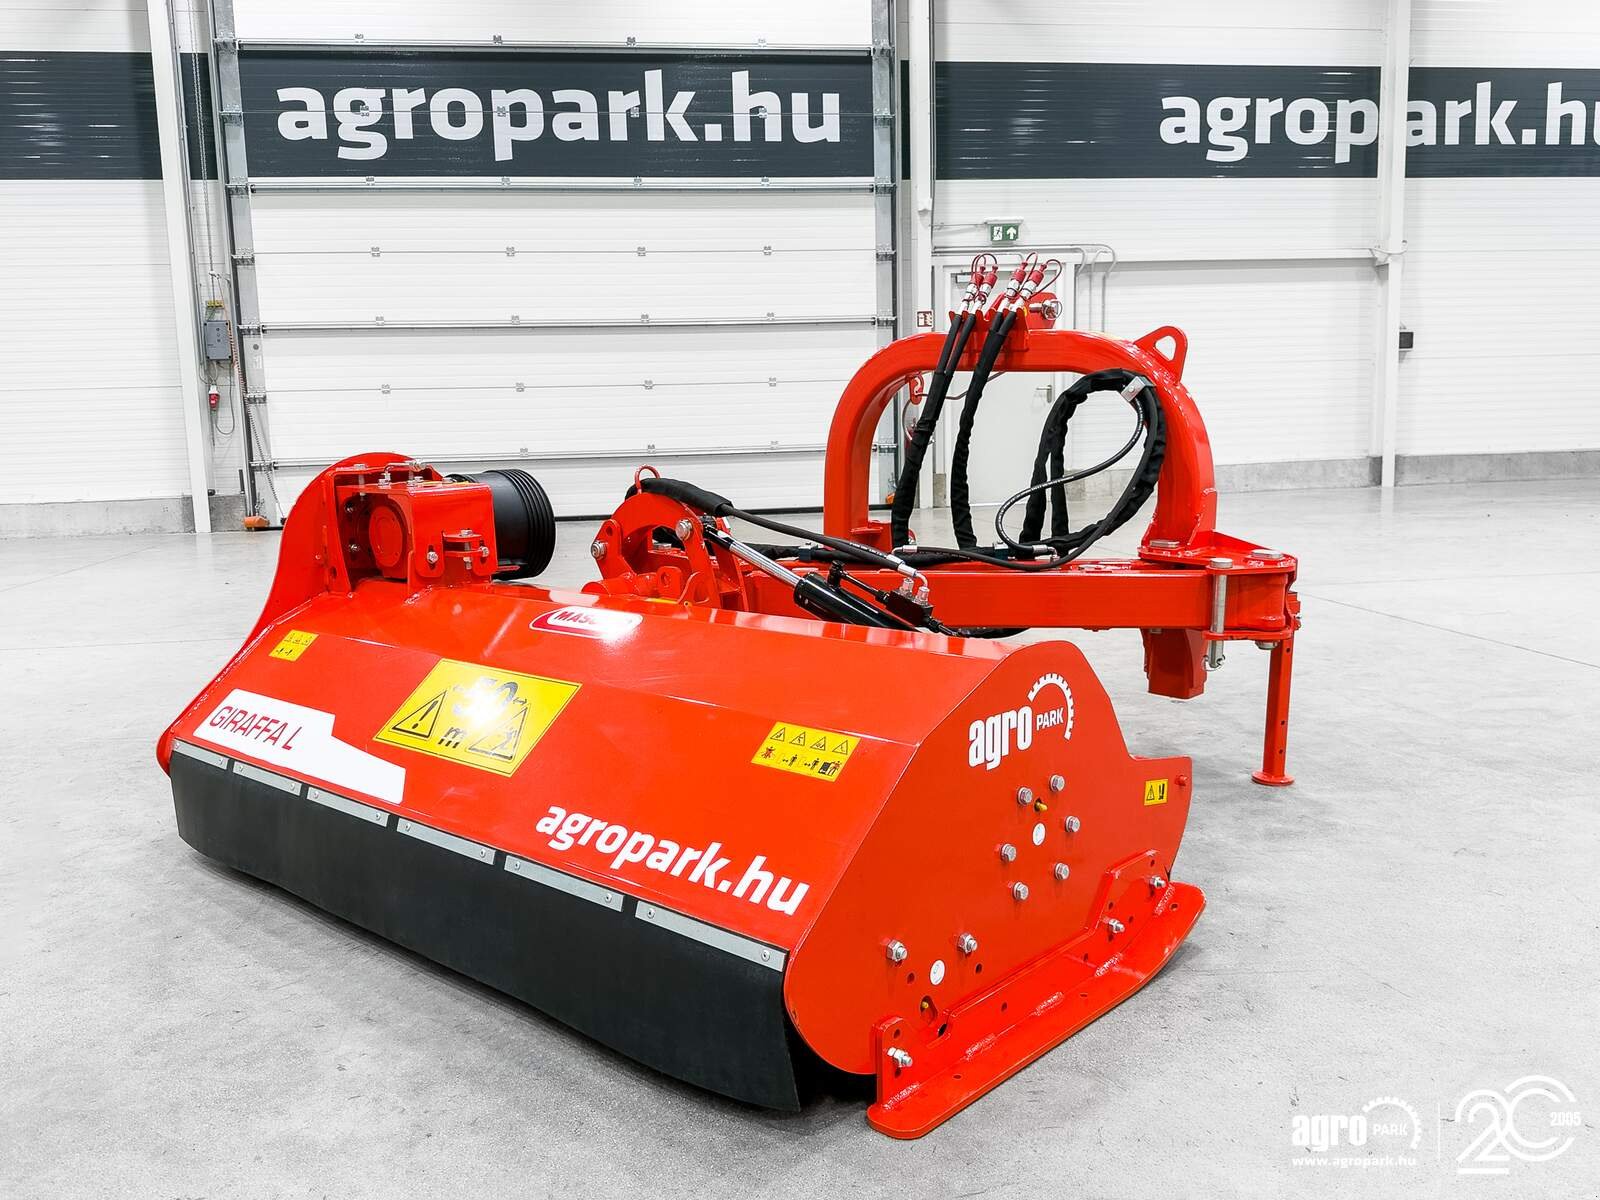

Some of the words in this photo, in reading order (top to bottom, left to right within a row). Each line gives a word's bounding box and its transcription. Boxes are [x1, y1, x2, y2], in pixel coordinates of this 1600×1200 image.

[276, 69, 841, 162] agropark.hu
[1159, 81, 1600, 164] agropark.h
[209, 705, 289, 747] GIRAFFA
[281, 726, 303, 751] L
[968, 705, 1033, 771] agro
[1036, 707, 1064, 731] PARK
[535, 805, 810, 916] agropark.hu
